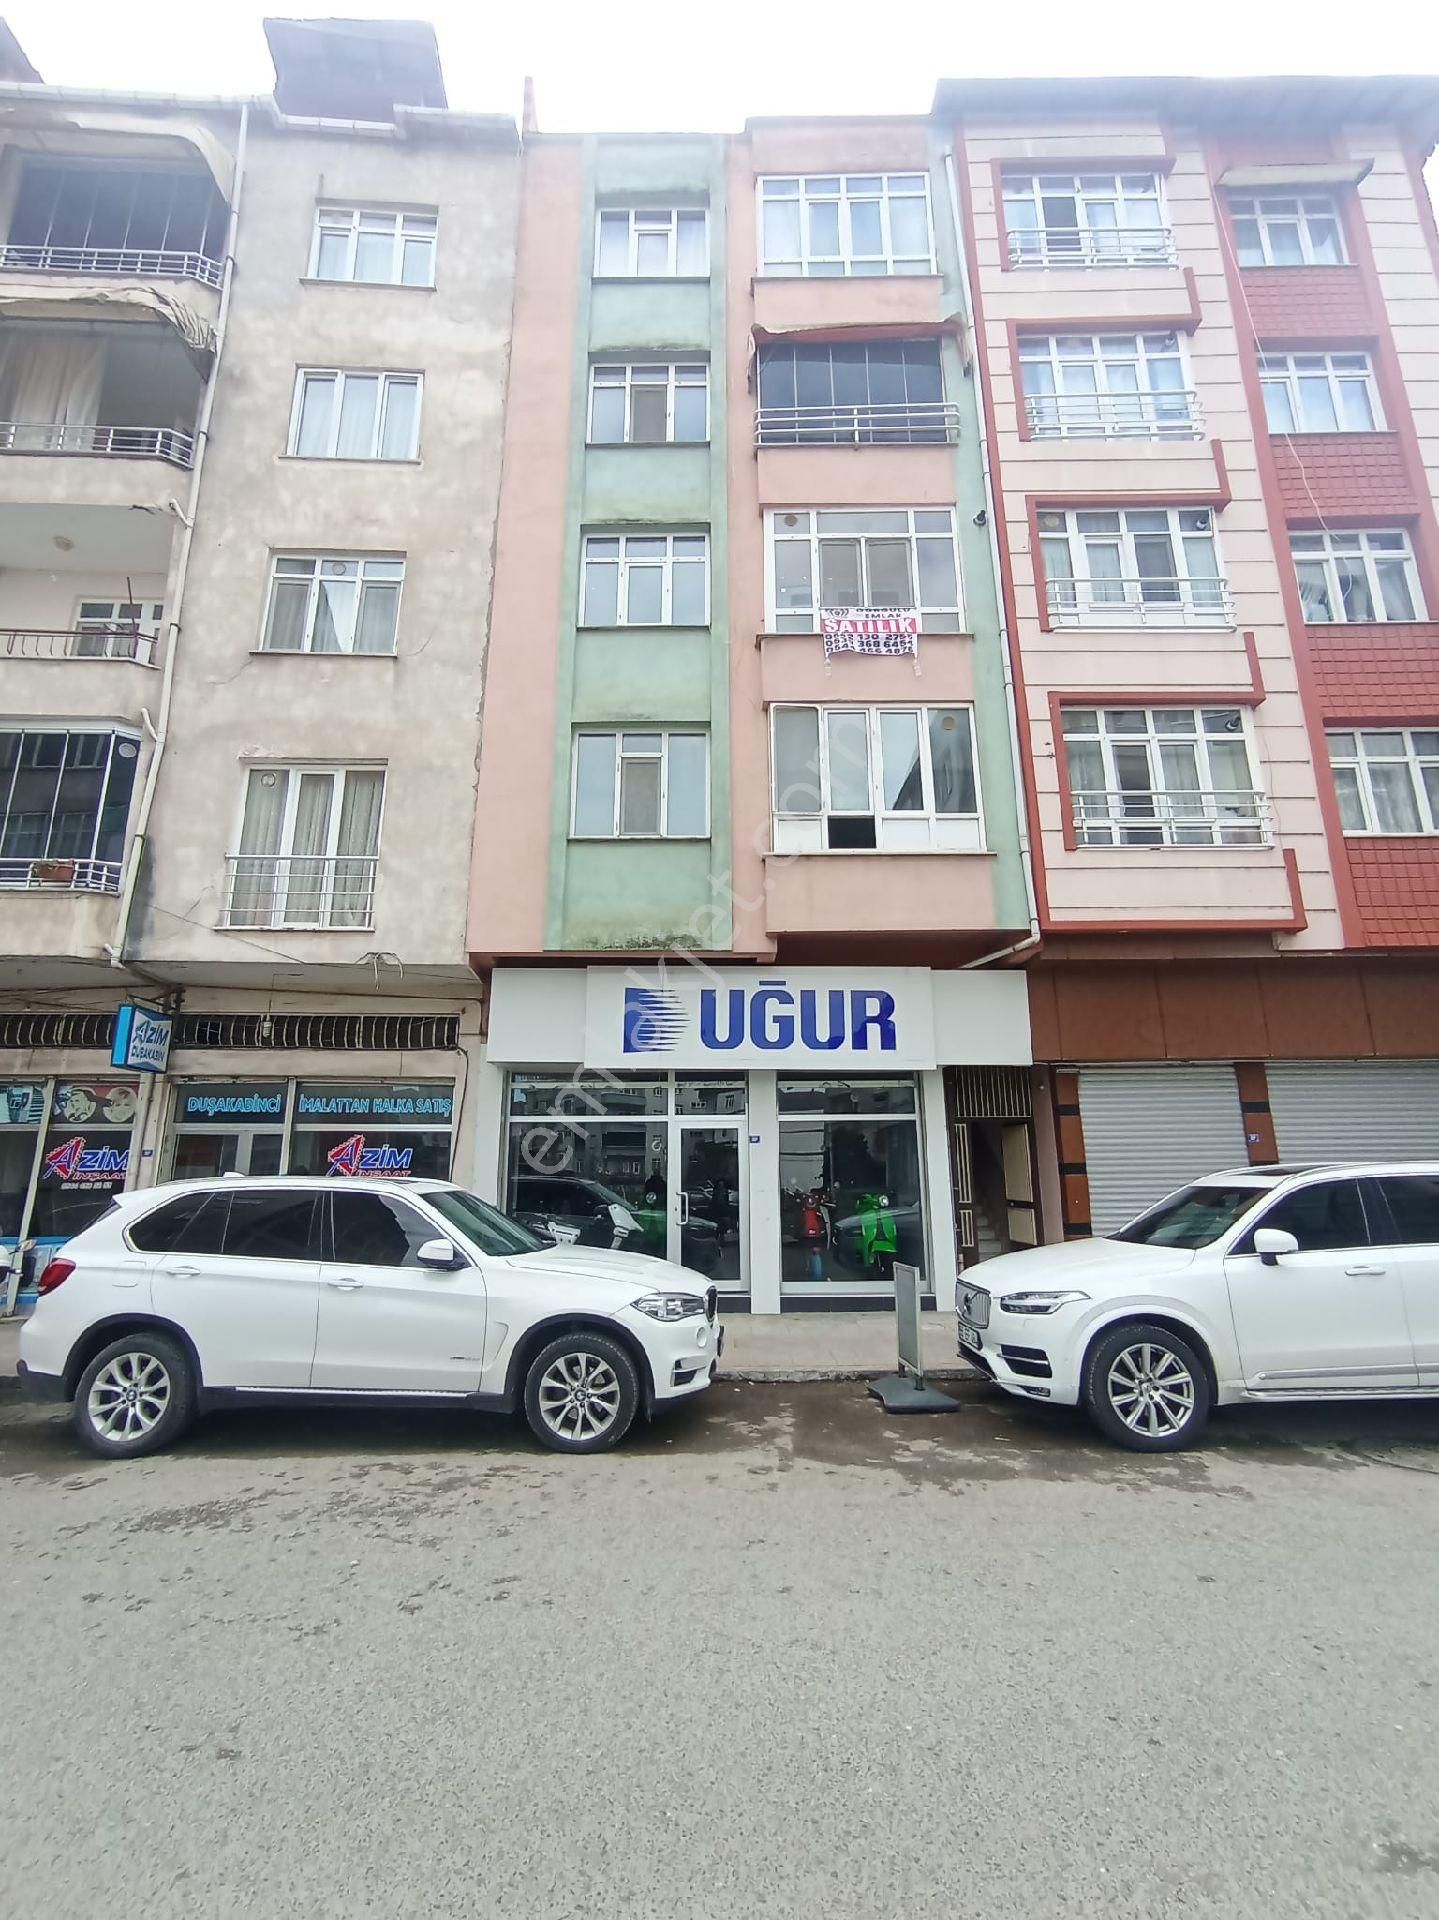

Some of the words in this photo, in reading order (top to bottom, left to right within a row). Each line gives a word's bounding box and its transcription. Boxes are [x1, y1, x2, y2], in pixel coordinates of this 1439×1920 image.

[823, 617, 915, 634] SATILIK
[187, 1093, 282, 1116] DUŞAKABİNCİ
[299, 1093, 369, 1113] İMALATTAN
[372, 1098, 414, 1113] HALKA
[415, 1098, 451, 1117] SATIŞ
[43, 1136, 129, 1179] AZİM
[326, 1134, 414, 1177] AZİM
